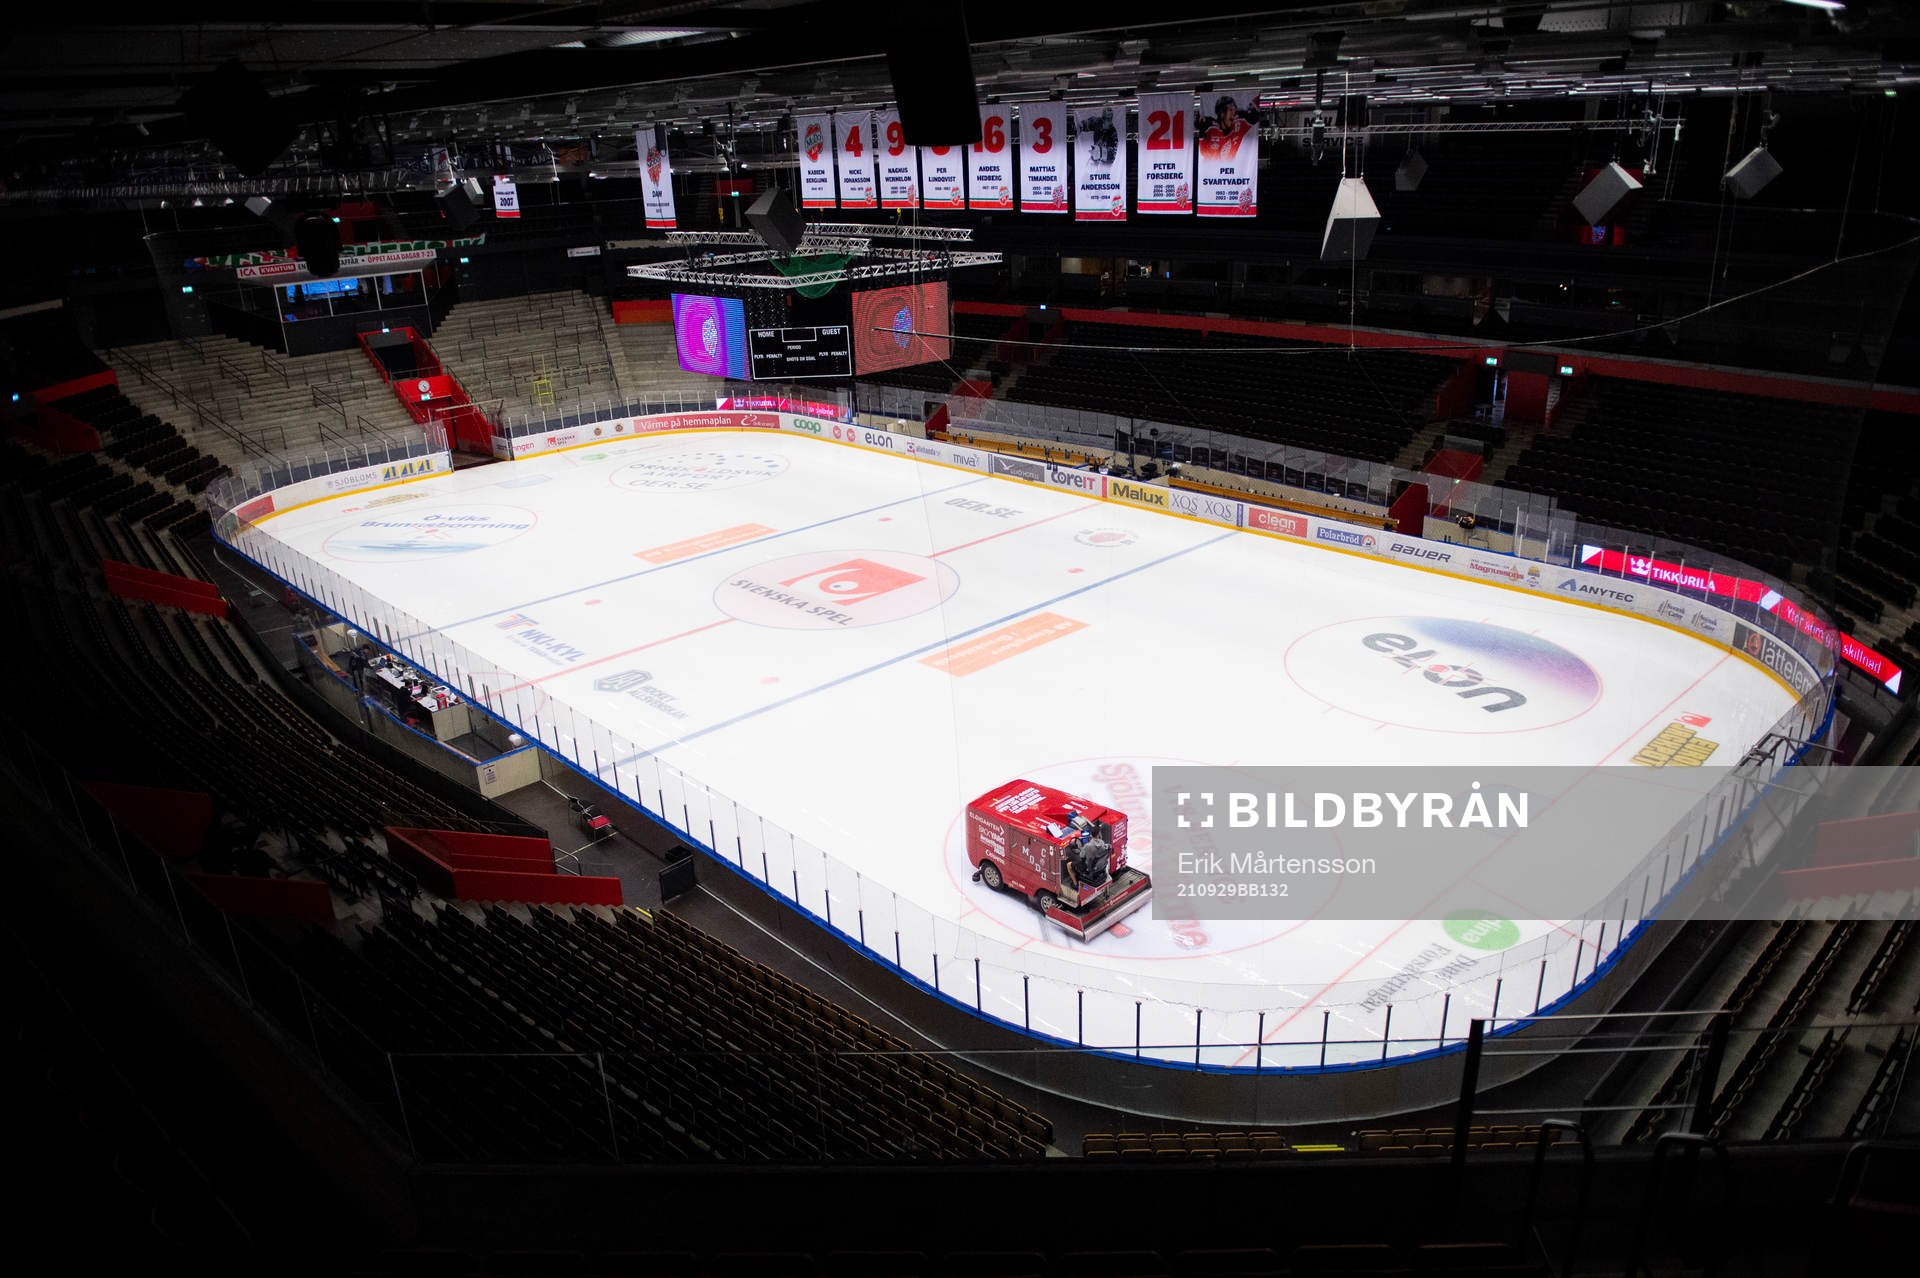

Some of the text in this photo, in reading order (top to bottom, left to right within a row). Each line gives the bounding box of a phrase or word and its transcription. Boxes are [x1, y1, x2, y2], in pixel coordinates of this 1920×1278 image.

[887, 121, 905, 156] 9
[1032, 117, 1053, 154] 3
[1147, 110, 1185, 150] 21
[845, 125, 864, 158] 4
[500, 197, 514, 206] 2007
[239, 268, 257, 277] ICA
[261, 265, 295, 275] KVANTUM
[367, 255, 385, 263] ÖPPET
[386, 254, 401, 262] ALLA
[401, 252, 421, 261] DAGAR
[822, 328, 841, 336] GUEST
[640, 416, 731, 430] Värme på hemmaplan
[793, 418, 822, 433] coop
[953, 453, 976, 467] miva
[334, 472, 377, 488] SJÖBLOMS
[629, 479, 713, 490] OER.SE
[641, 471, 737, 480] AIRPORT
[1112, 482, 1165, 506] Malux
[943, 496, 1023, 520] OER.SE
[1172, 493, 1198, 512] XQS
[1204, 500, 1233, 521] XQS
[423, 513, 490, 522] Ö-viks
[1258, 512, 1296, 530] clean
[1319, 528, 1360, 545] Polarbröd
[1390, 543, 1452, 563] BAUER
[1652, 567, 1716, 592] TIKKURILA
[729, 578, 857, 627] SVENSKA SPEL
[1579, 585, 1635, 603] ANYTEC
[518, 628, 586, 662] NKI-KYL
[1843, 644, 1882, 675] skillnad
[639, 684, 680, 704] HOCKEY
